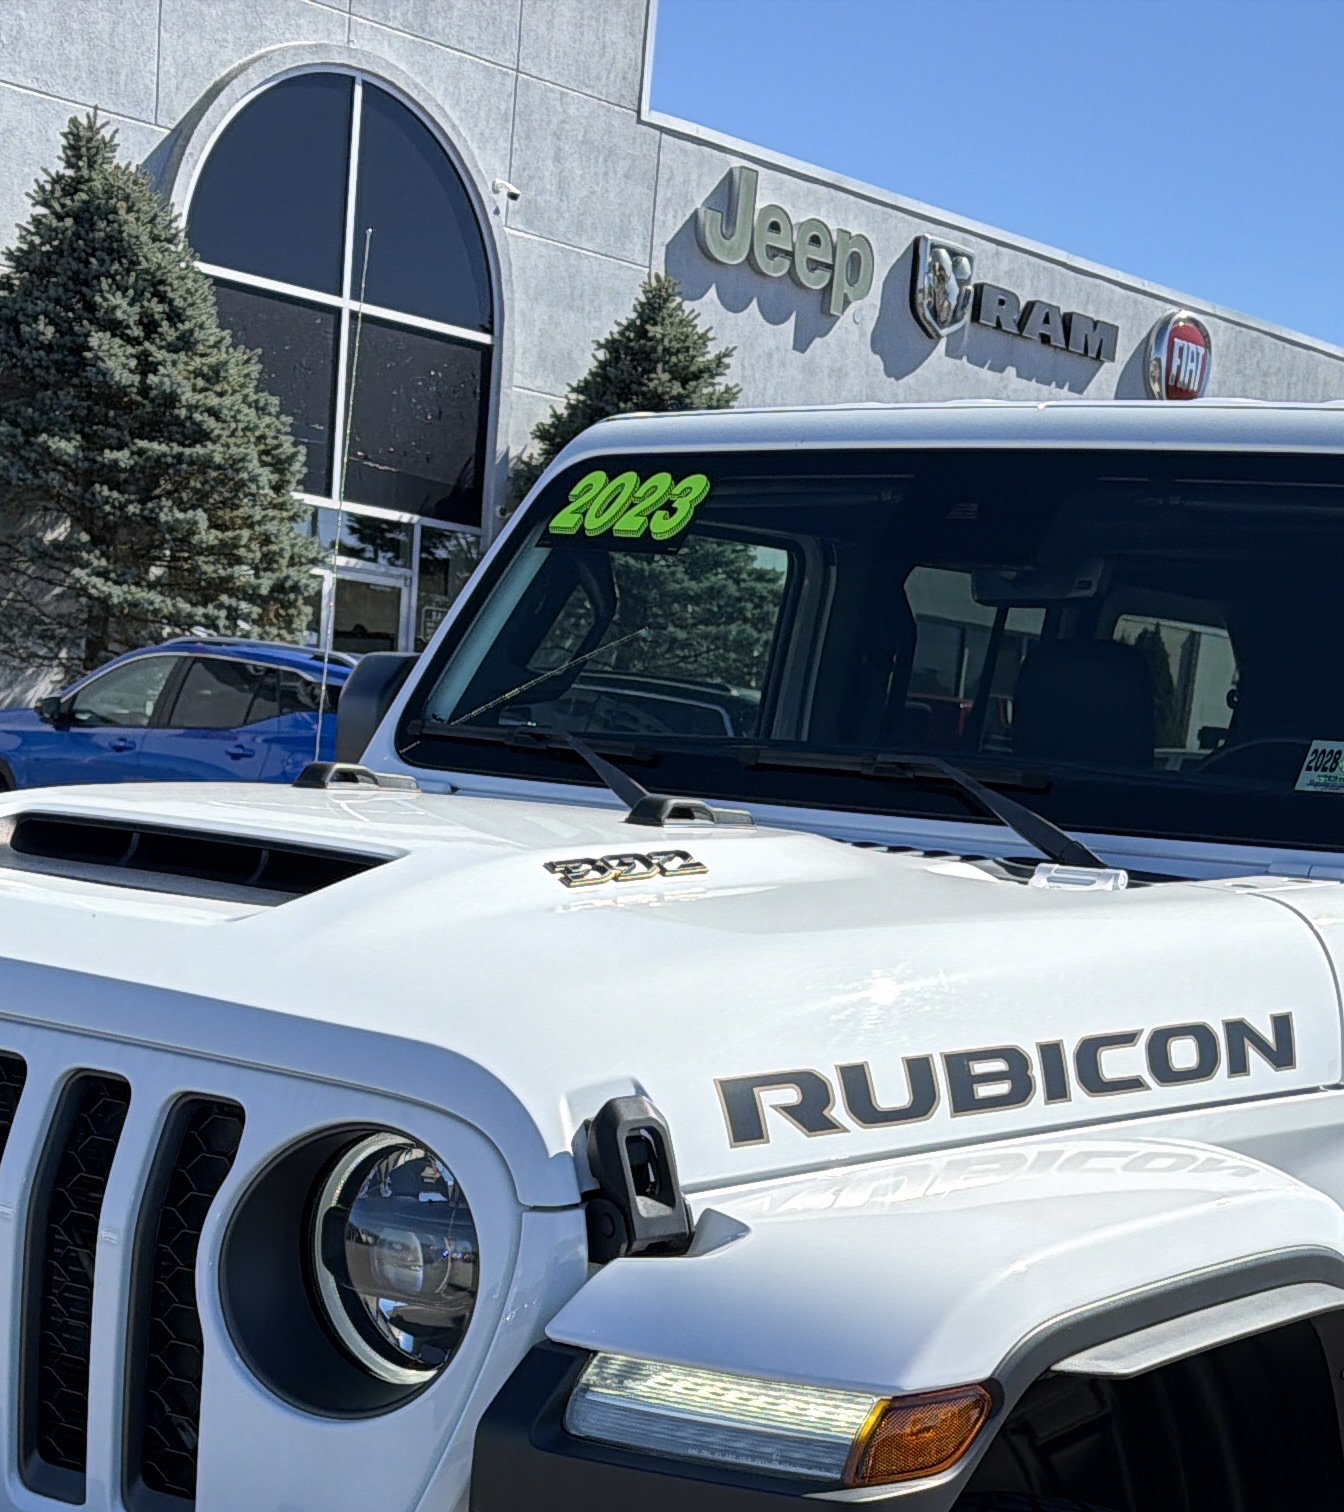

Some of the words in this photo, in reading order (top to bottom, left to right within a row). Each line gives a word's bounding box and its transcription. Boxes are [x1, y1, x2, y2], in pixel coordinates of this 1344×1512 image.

[697, 166, 875, 317] Jeep
[974, 282, 1119, 363] RAM
[1171, 336, 1207, 391] FIAT
[549, 470, 711, 541] 2023
[1304, 748, 1343, 773] 2028
[713, 1010, 1298, 1149] RUBICON
